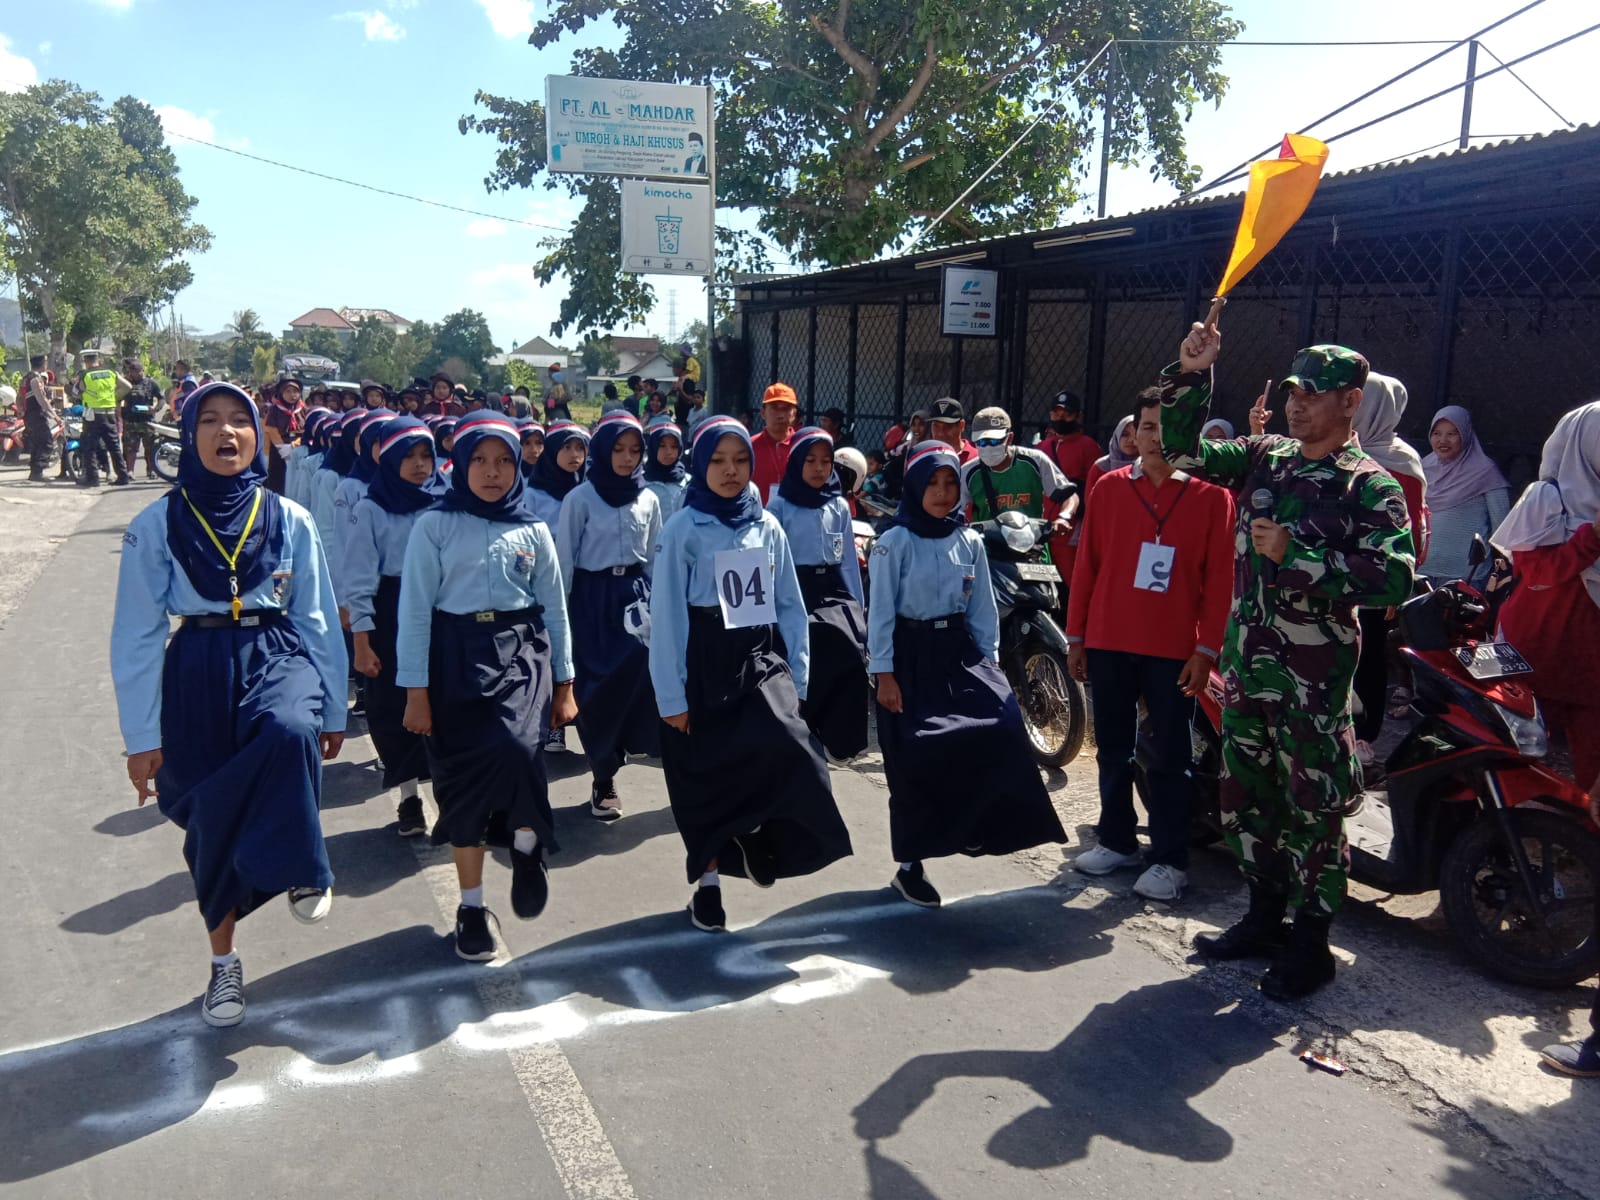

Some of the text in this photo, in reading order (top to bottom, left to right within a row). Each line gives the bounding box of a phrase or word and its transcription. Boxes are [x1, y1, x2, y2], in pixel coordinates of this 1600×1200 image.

[562, 99, 584, 114] PT.
[591, 101, 610, 116] AL
[630, 104, 696, 121] MAHDAR
[575, 131, 685, 149] UMROH & HAJI KHUSUS
[644, 186, 693, 200] kimocha
[722, 566, 766, 608] 04
